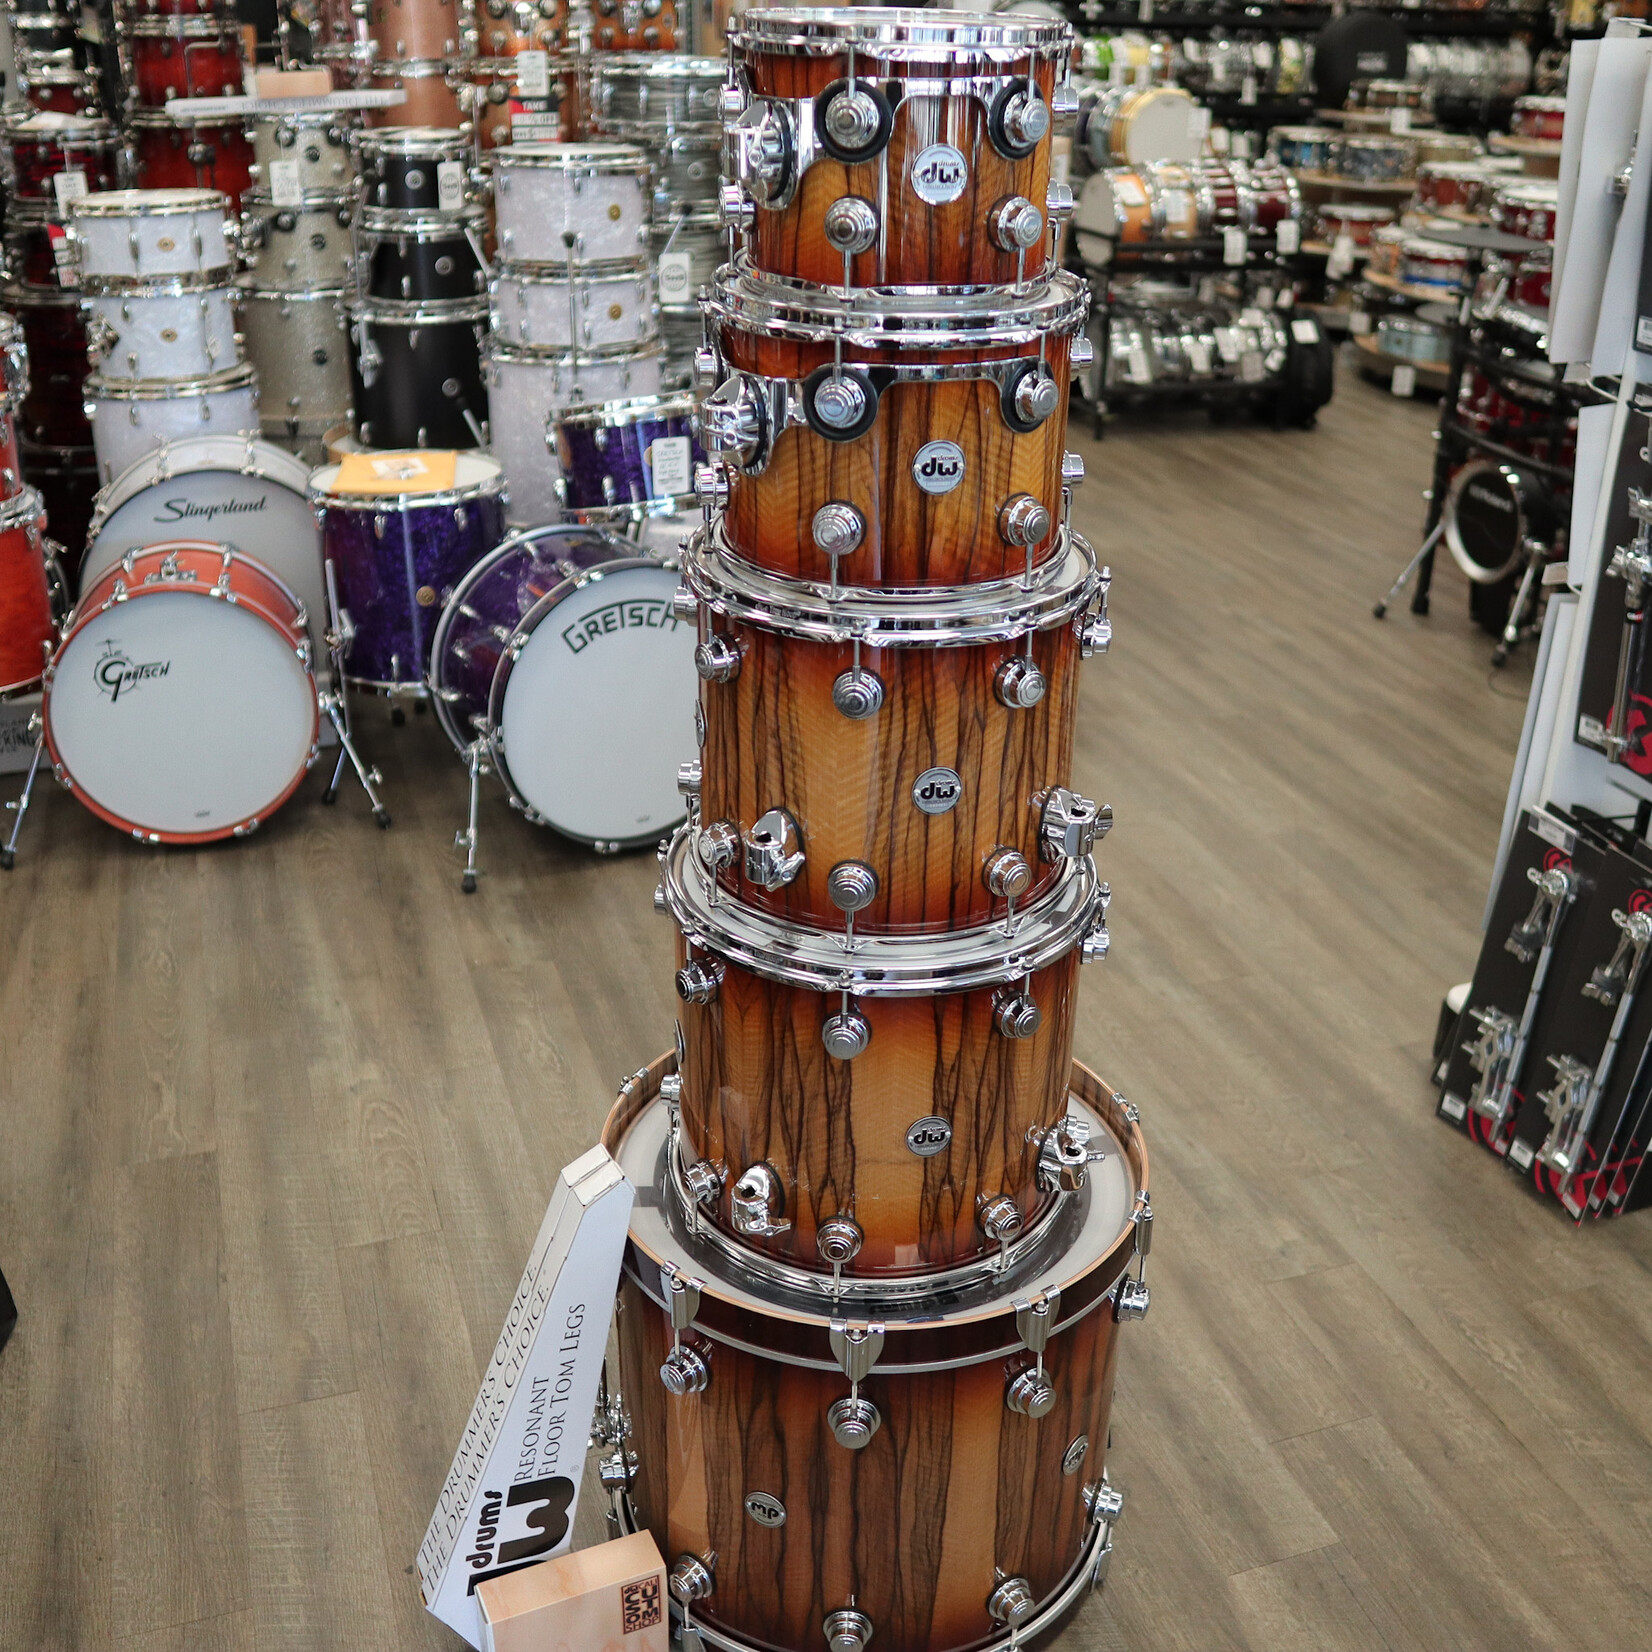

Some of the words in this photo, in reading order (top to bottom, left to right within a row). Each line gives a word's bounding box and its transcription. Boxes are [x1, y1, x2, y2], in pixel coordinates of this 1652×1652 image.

[920, 162, 959, 184] dw
[921, 456, 958, 477] dw
[153, 495, 267, 522] Slingerland
[561, 598, 678, 654] GRETSCH
[920, 782, 955, 800] dw
[913, 1129, 946, 1144] dw
[560, 1303, 586, 1352] LEGS
[549, 1359, 575, 1408] TOM
[514, 1377, 549, 1482] RESONANT
[538, 1410, 566, 1477] FLOOR
[421, 1516, 440, 1564] THE
[440, 1370, 495, 1514] DRUMMER'S
[425, 1541, 447, 1591] THE
[446, 1393, 505, 1540] DRUMMER'S
[465, 1490, 502, 1568] drums
[626, 1616, 659, 1632] SHOP
